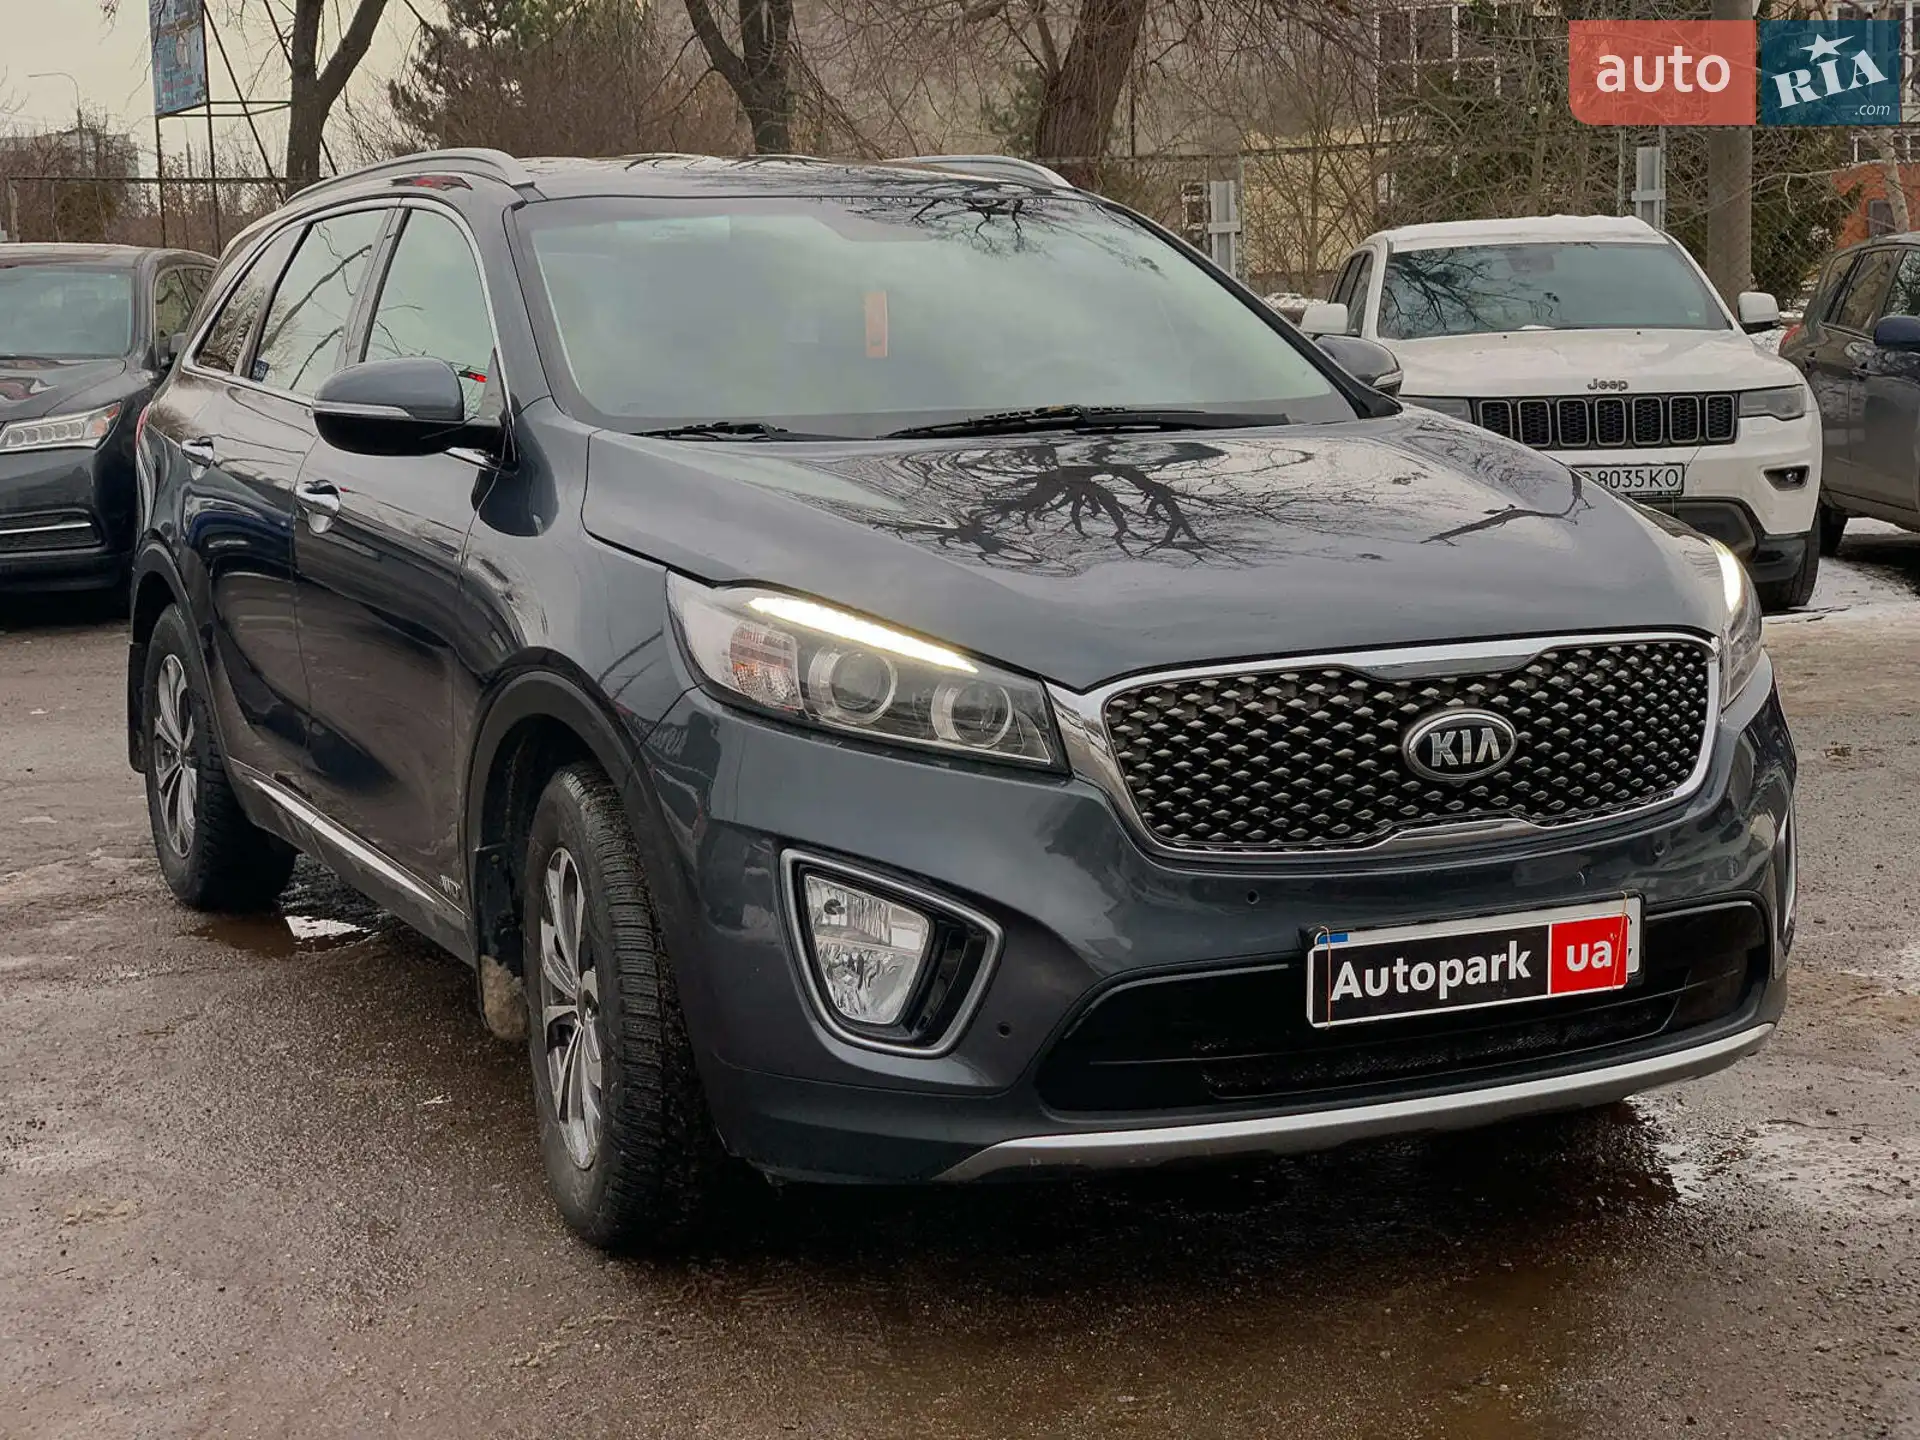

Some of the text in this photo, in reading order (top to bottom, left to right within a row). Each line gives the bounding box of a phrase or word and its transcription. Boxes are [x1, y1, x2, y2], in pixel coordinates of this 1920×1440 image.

[1587, 378, 1629, 392] Jeep
[1429, 727, 1501, 767] KIA
[1330, 939, 1613, 1001] Autopark ua
